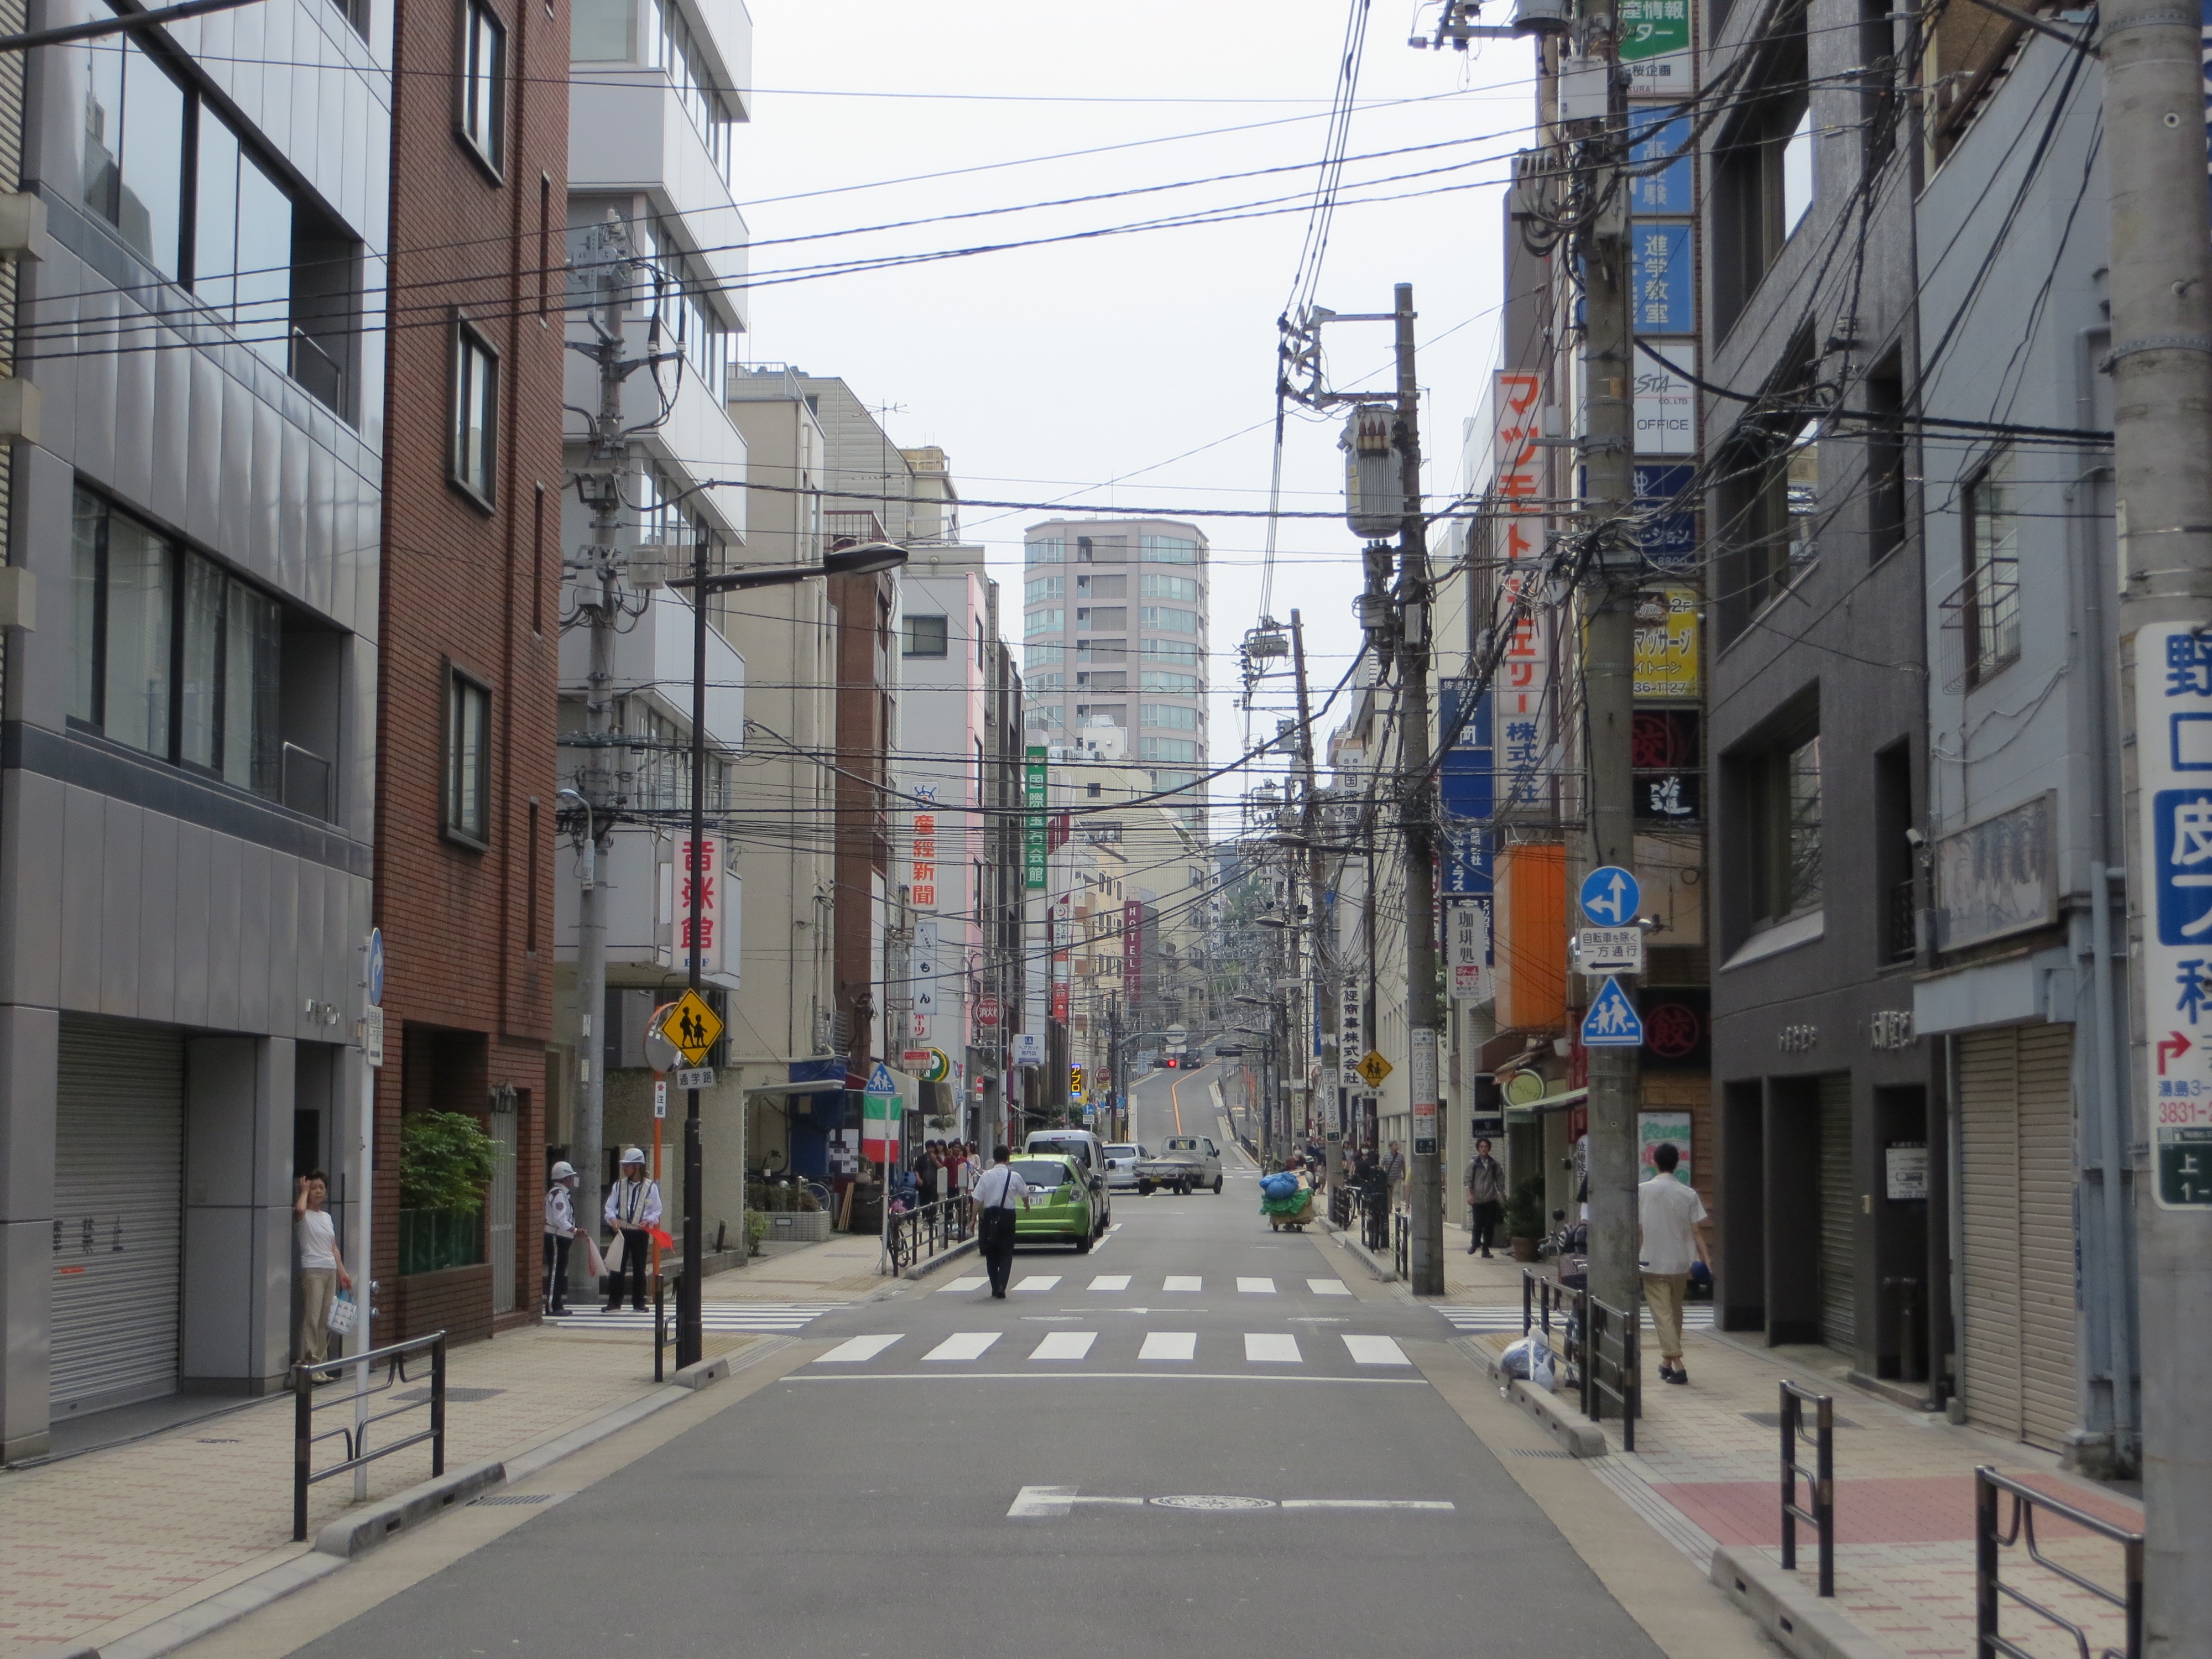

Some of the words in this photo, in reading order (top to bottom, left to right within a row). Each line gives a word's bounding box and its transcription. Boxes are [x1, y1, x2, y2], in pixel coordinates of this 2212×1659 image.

[1645, 235, 1668, 324] 進学教室
[1637, 419, 1688, 430] OFFICE
[1671, 598, 1692, 613] 2F
[1634, 628, 1692, 656] マッサージ
[1458, 910, 1475, 963] 珈琲処
[1583, 932, 1636, 943] 自転車を除く
[1583, 946, 1637, 957] 一方通行
[679, 1071, 712, 1086] 通学路
[1415, 1052, 1423, 1101] クリニック
[1425, 1052, 1434, 1101] あさひ上野
[657, 1094, 664, 1115] 注意
